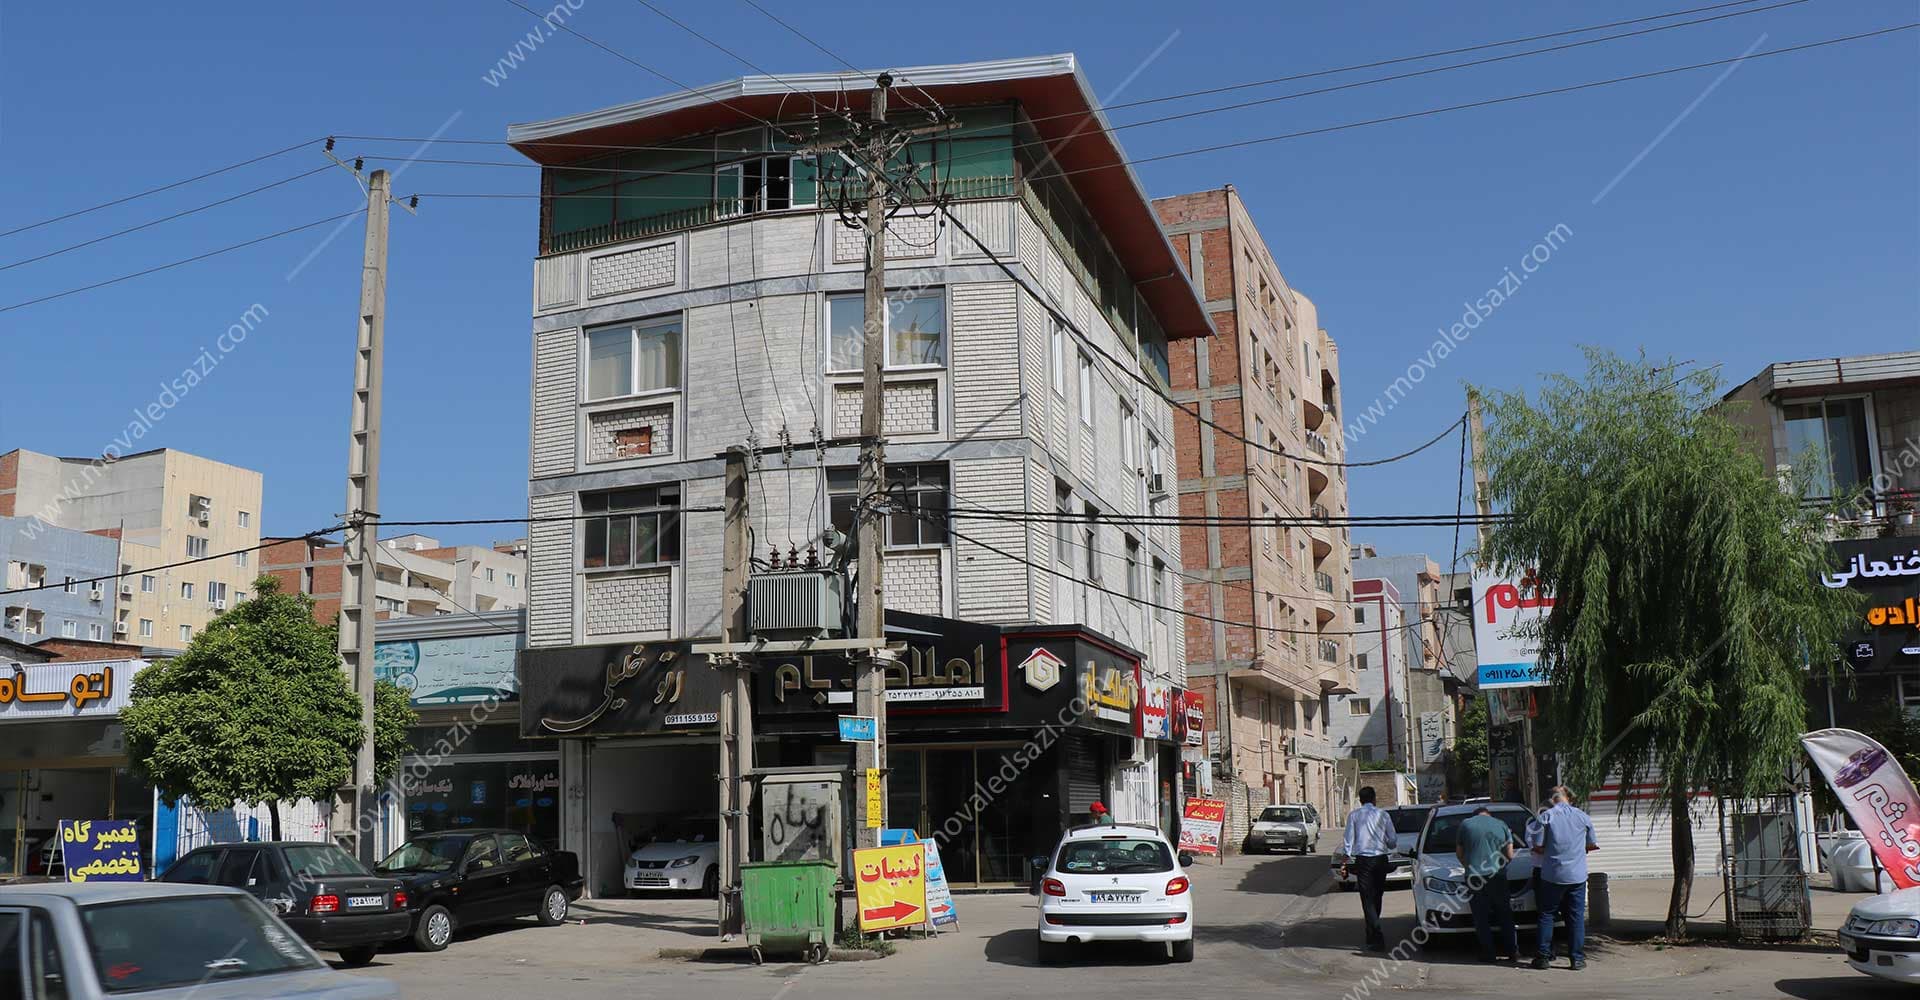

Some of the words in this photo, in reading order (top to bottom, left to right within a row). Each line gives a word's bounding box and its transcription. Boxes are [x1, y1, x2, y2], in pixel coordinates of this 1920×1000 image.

[1821, 550, 1920, 588] ختمانی
[71, 666, 112, 708] اتو
[64, 820, 92, 843] گاه
[93, 821, 137, 851] تعمیر
[69, 851, 140, 883] تخصصی
[860, 853, 921, 887] لبنیات
